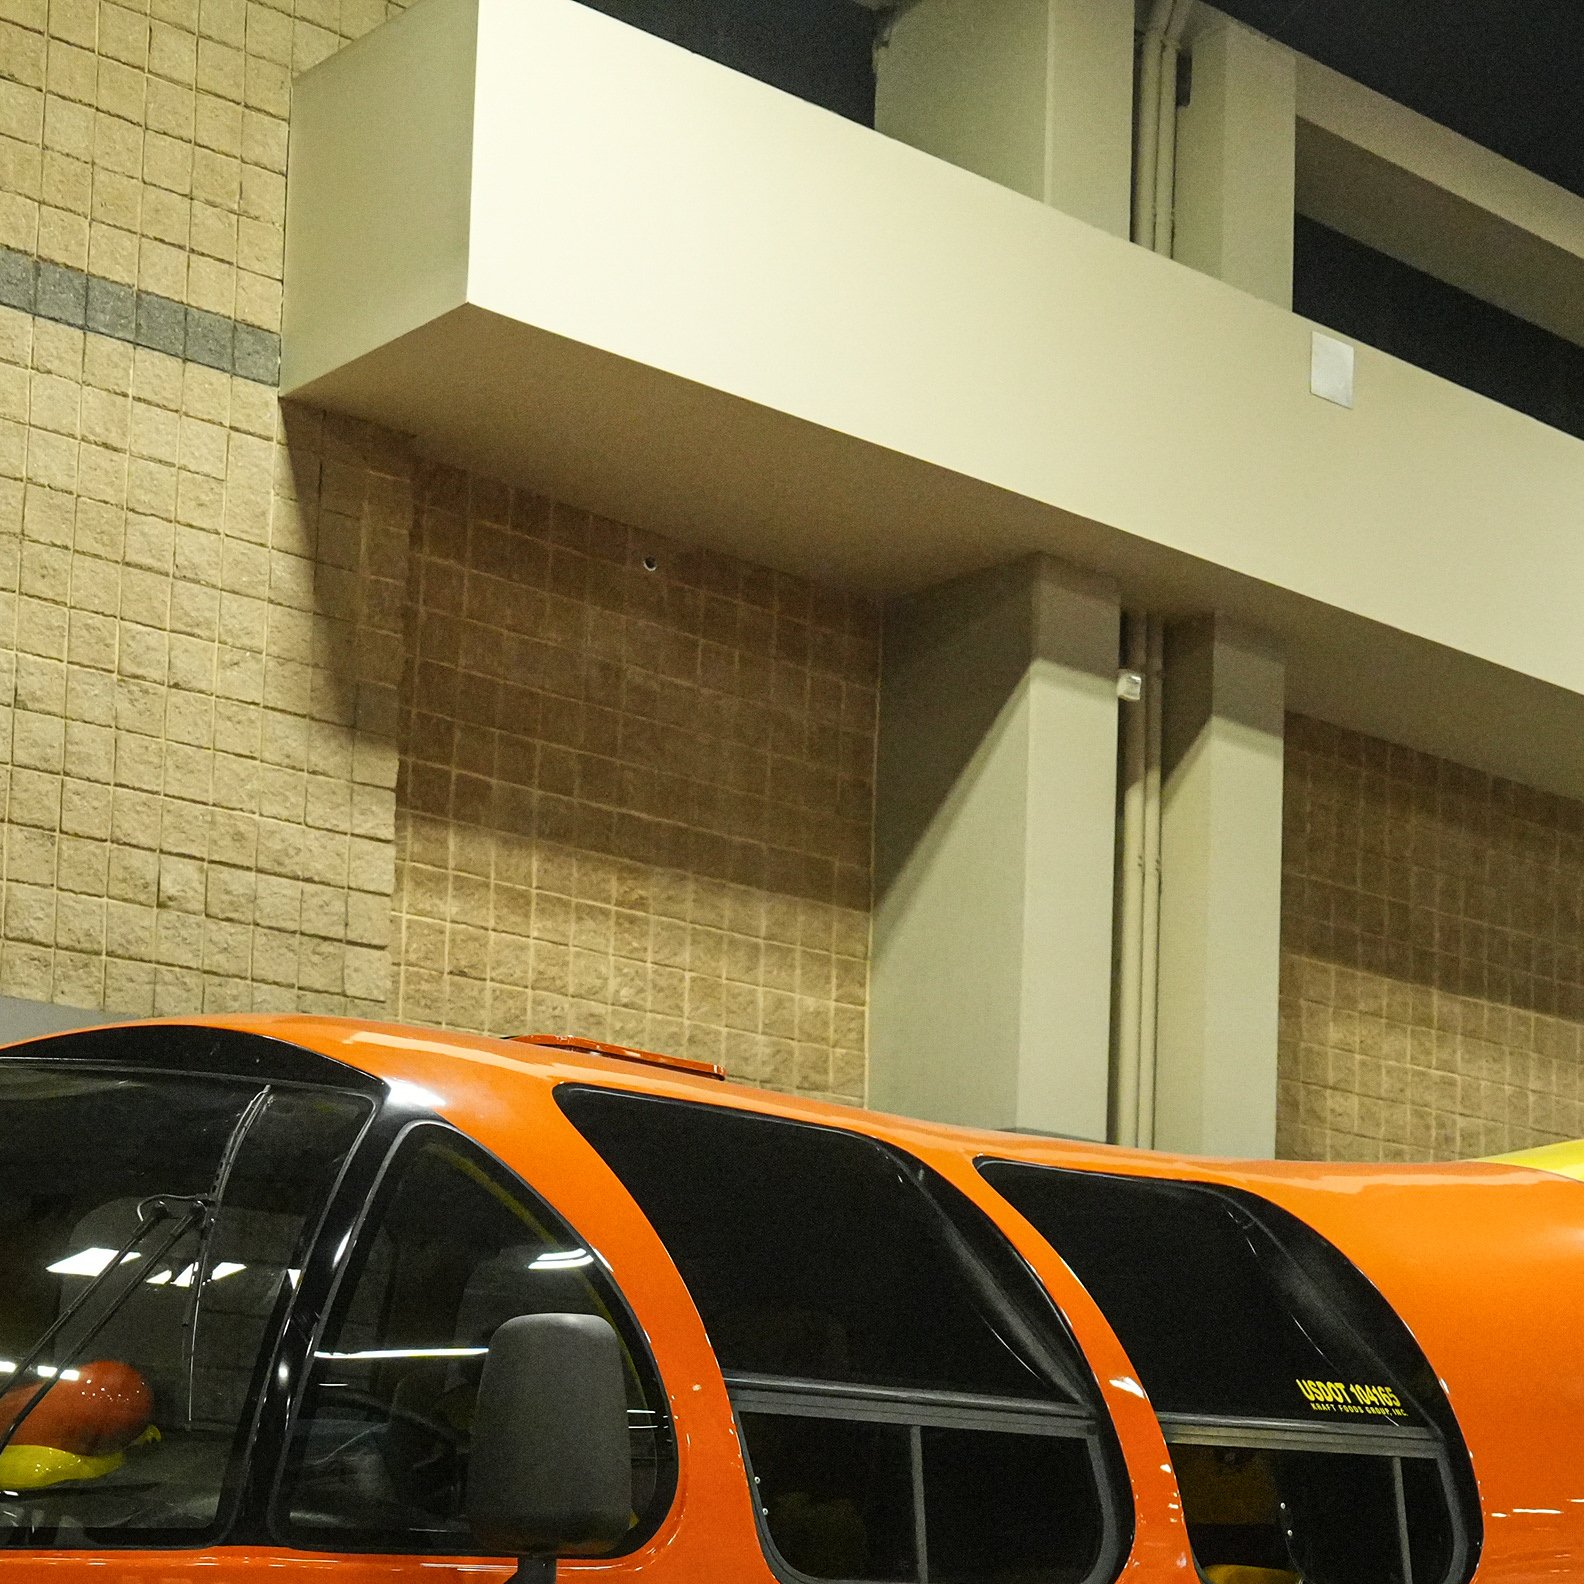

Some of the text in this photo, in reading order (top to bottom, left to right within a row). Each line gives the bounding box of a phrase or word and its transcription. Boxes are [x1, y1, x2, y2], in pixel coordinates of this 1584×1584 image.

[1296, 1379, 1401, 1407] USDOT 104165
[1310, 1402, 1336, 1411] KRAFT
[1339, 1404, 1364, 1413] FOODS
[1393, 1408, 1408, 1416] INC.
